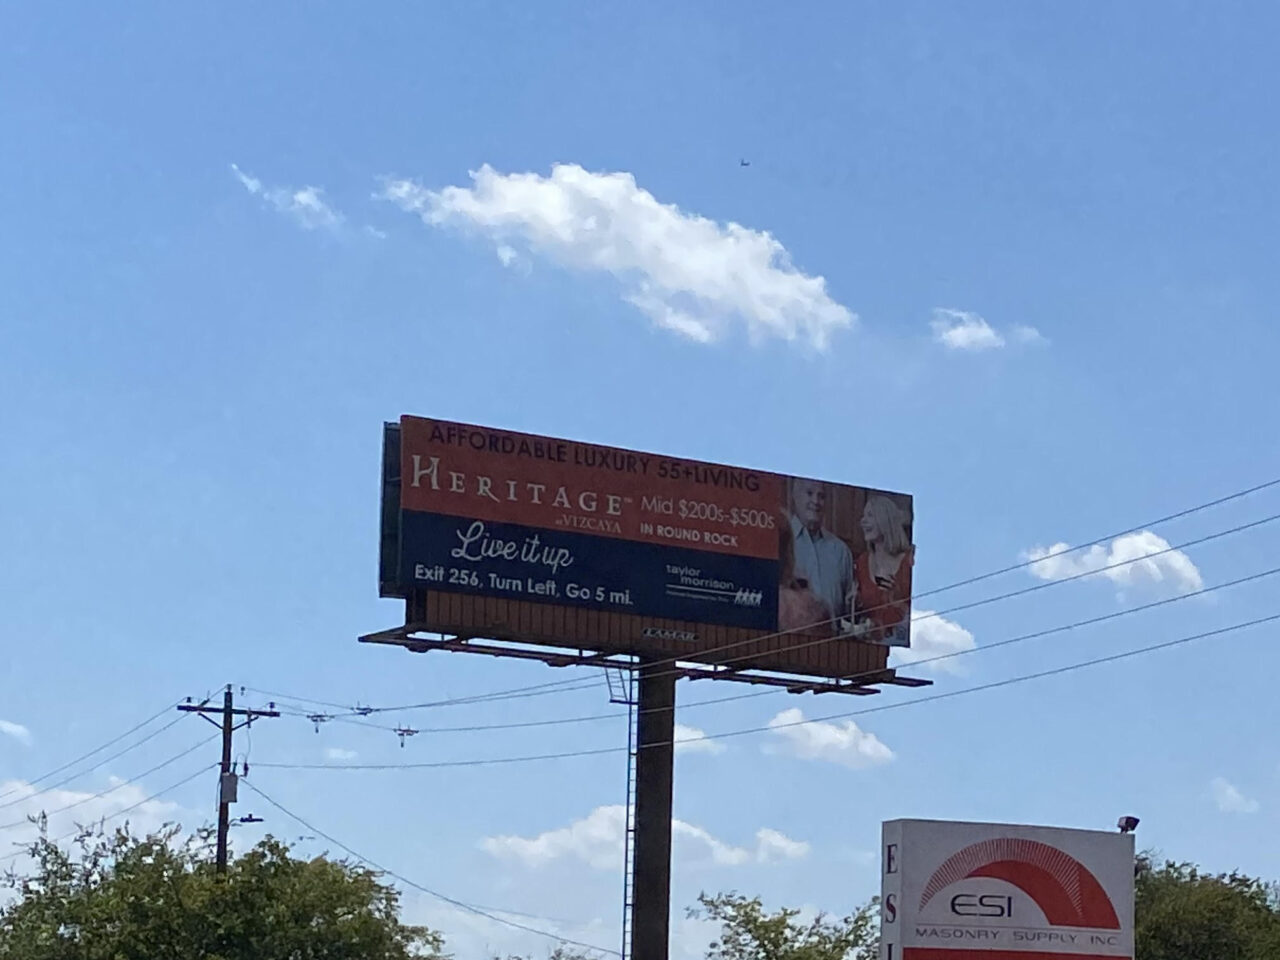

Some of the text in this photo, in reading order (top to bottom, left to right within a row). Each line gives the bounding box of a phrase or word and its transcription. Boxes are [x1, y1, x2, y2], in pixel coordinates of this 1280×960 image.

[429, 425, 567, 462] AFFORDABLE
[575, 446, 650, 474] LUXURY
[411, 455, 622, 516] HERITAGE
[562, 514, 622, 533] VIZCAYA
[641, 496, 775, 529] Mid $200s-$500s
[451, 521, 574, 574] Live it up
[640, 523, 739, 547] IN ROUND ROCK
[415, 564, 444, 582] Exit
[449, 568, 483, 588] 256,
[488, 573, 522, 592] Turn
[527, 579, 561, 598] Left,
[565, 583, 590, 601] Go
[595, 587, 605, 602] 5
[666, 564, 734, 590] taylor morrison
[950, 894, 1012, 917] ESI
[915, 928, 1119, 946] MASONRY SUPPLY INC
